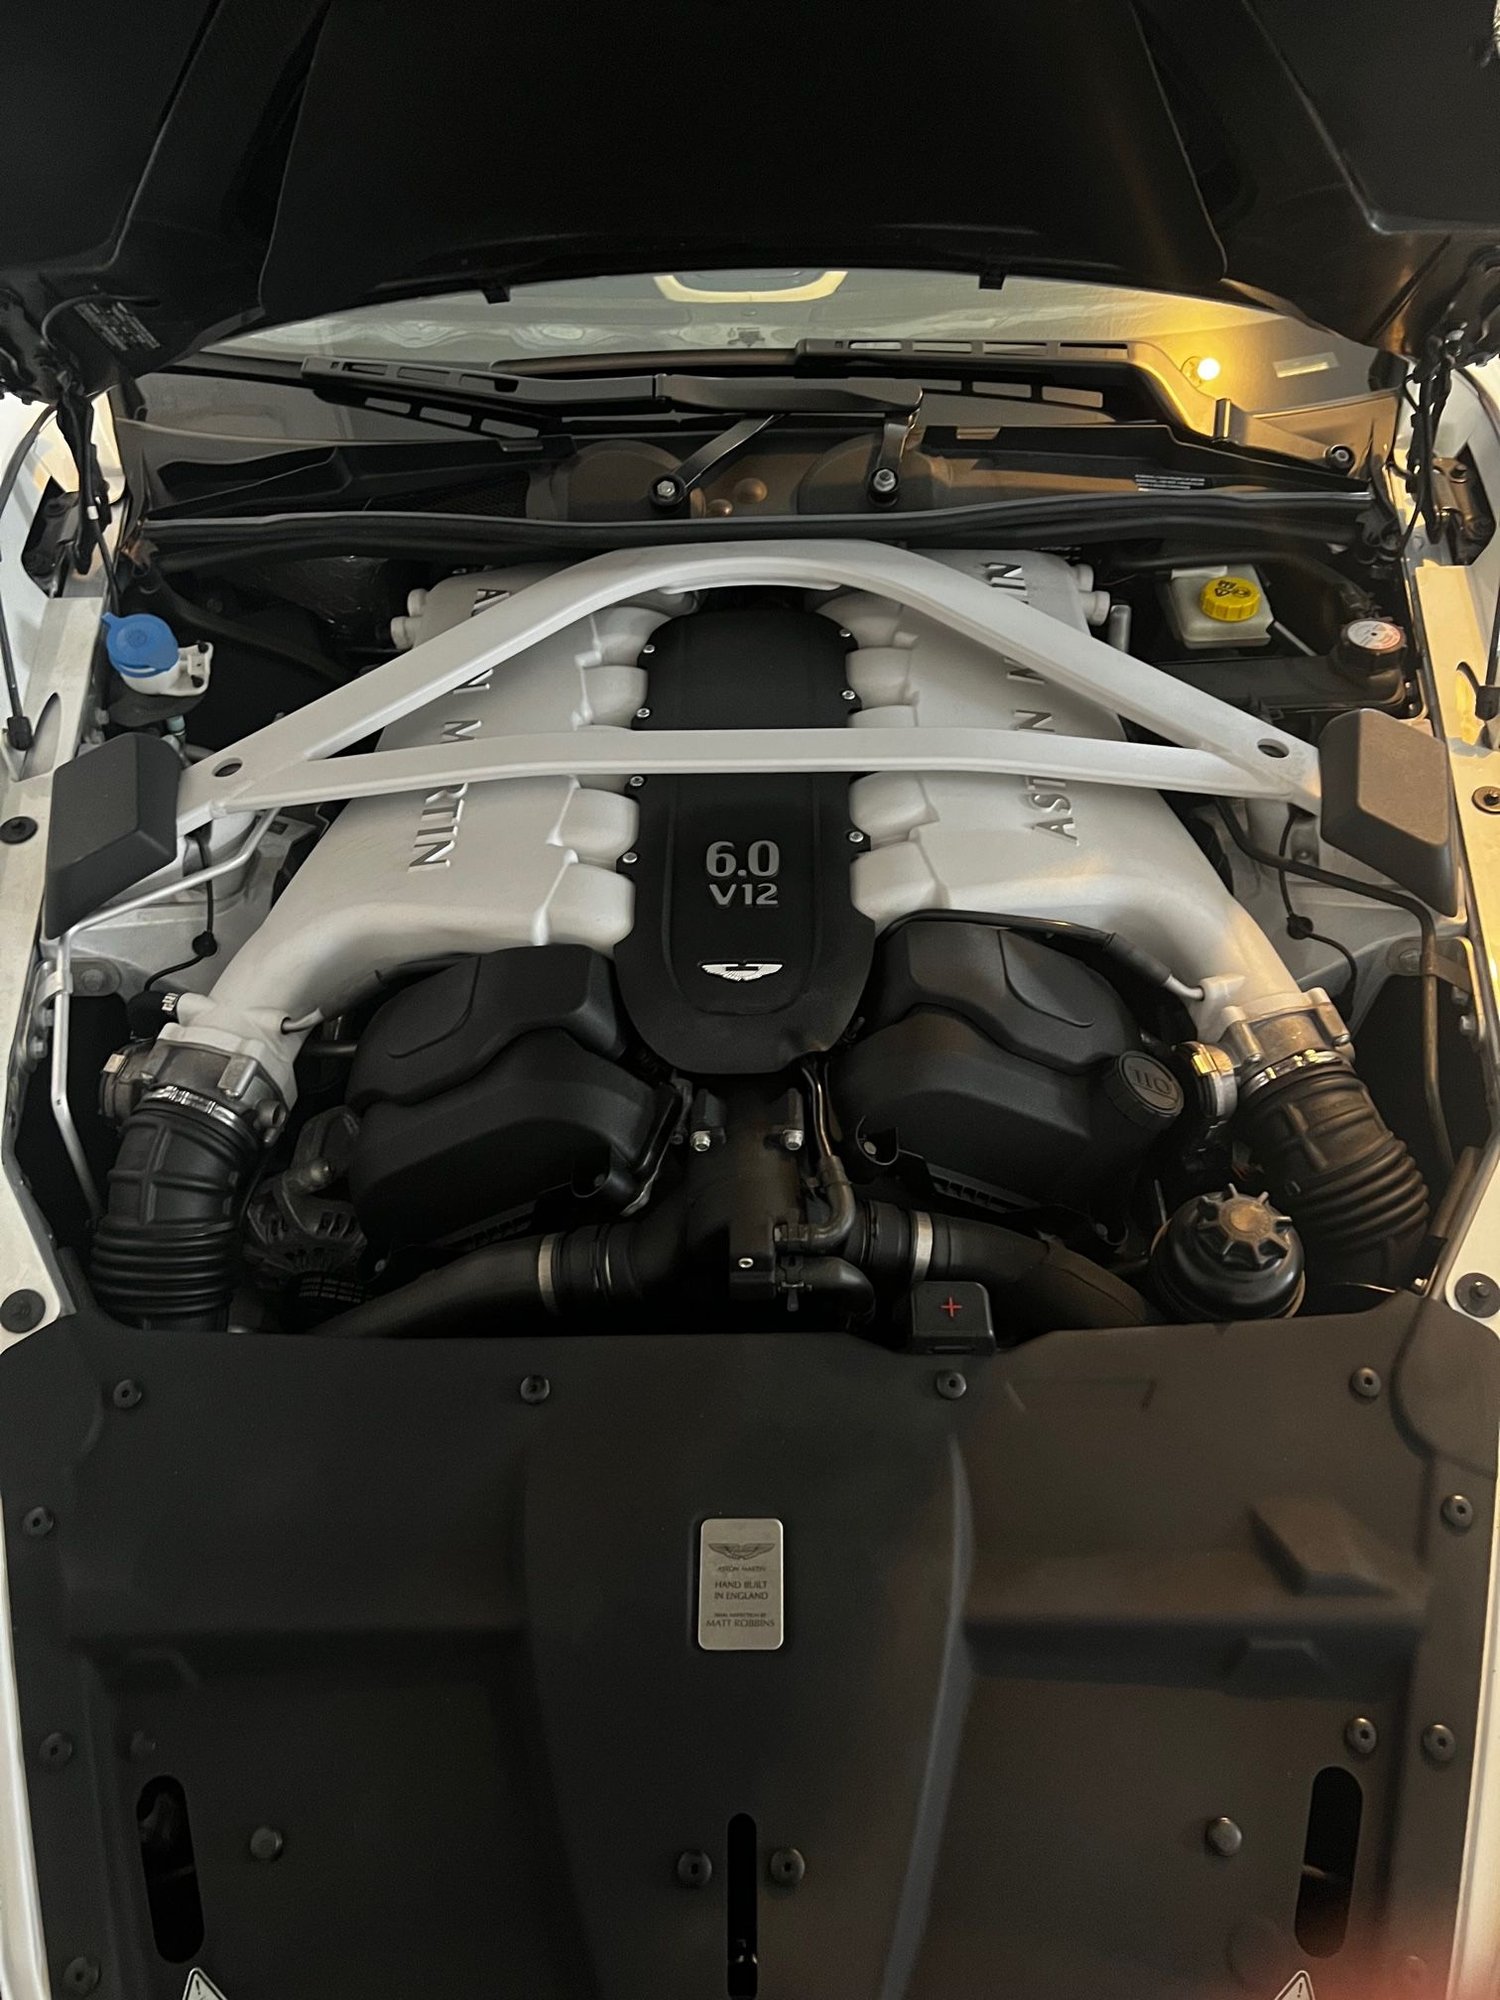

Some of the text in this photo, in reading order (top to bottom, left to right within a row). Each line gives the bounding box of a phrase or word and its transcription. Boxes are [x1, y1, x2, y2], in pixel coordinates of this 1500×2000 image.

[706, 840, 780, 877] 6.0
[709, 883, 778, 906] V12
[1128, 1066, 1172, 1095] OIL
[715, 1580, 767, 1589] HAND BUILT
[714, 1592, 769, 1600] IN ENGLAND
[706, 1619, 732, 1628] MATT
